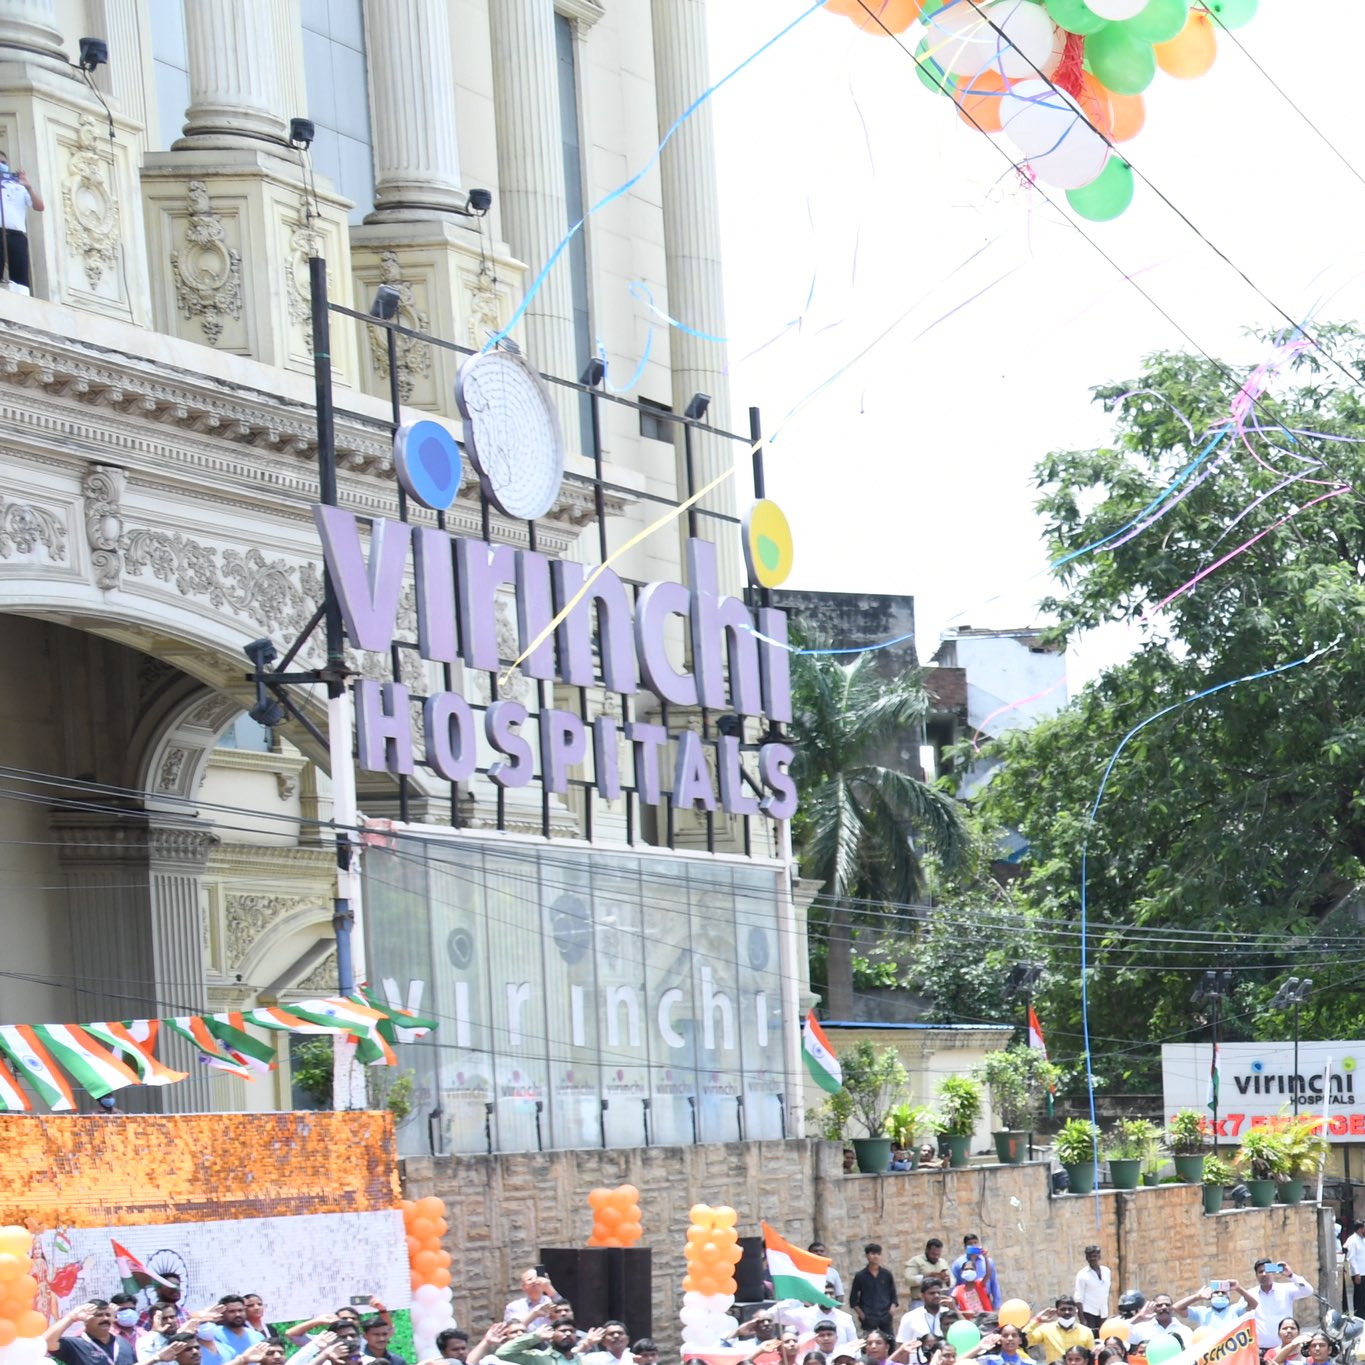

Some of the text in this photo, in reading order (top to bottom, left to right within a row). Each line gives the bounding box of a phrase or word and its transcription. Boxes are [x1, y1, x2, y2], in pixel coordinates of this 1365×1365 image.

[354, 679, 798, 820] HOSPITALS
[1234, 1064, 1353, 1095] virinchi
[1290, 1095, 1356, 1106] HOSPITALS
[1170, 1113, 1245, 1137] x7
